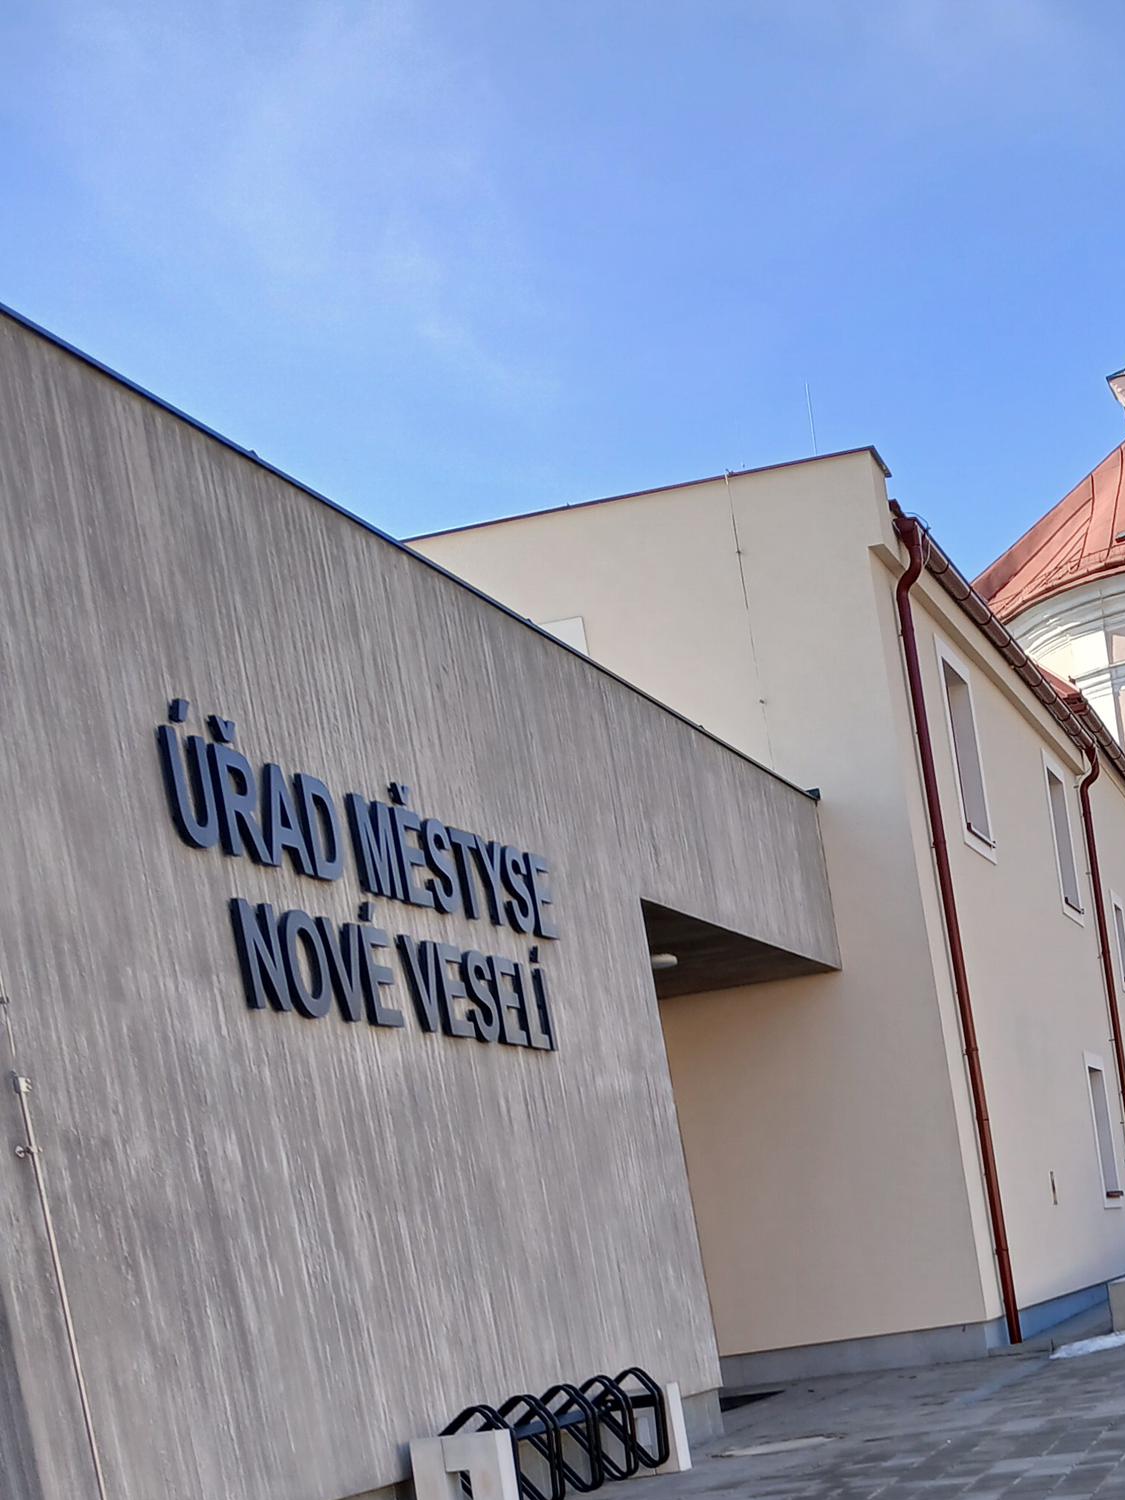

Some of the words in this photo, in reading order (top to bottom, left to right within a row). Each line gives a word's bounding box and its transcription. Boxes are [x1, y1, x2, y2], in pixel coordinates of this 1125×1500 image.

[159, 698, 344, 882] ÚŘAD
[346, 782, 560, 939] MĚSTYSE
[230, 898, 404, 1028] NOVÉ
[396, 934, 558, 1052] VESELÍ
